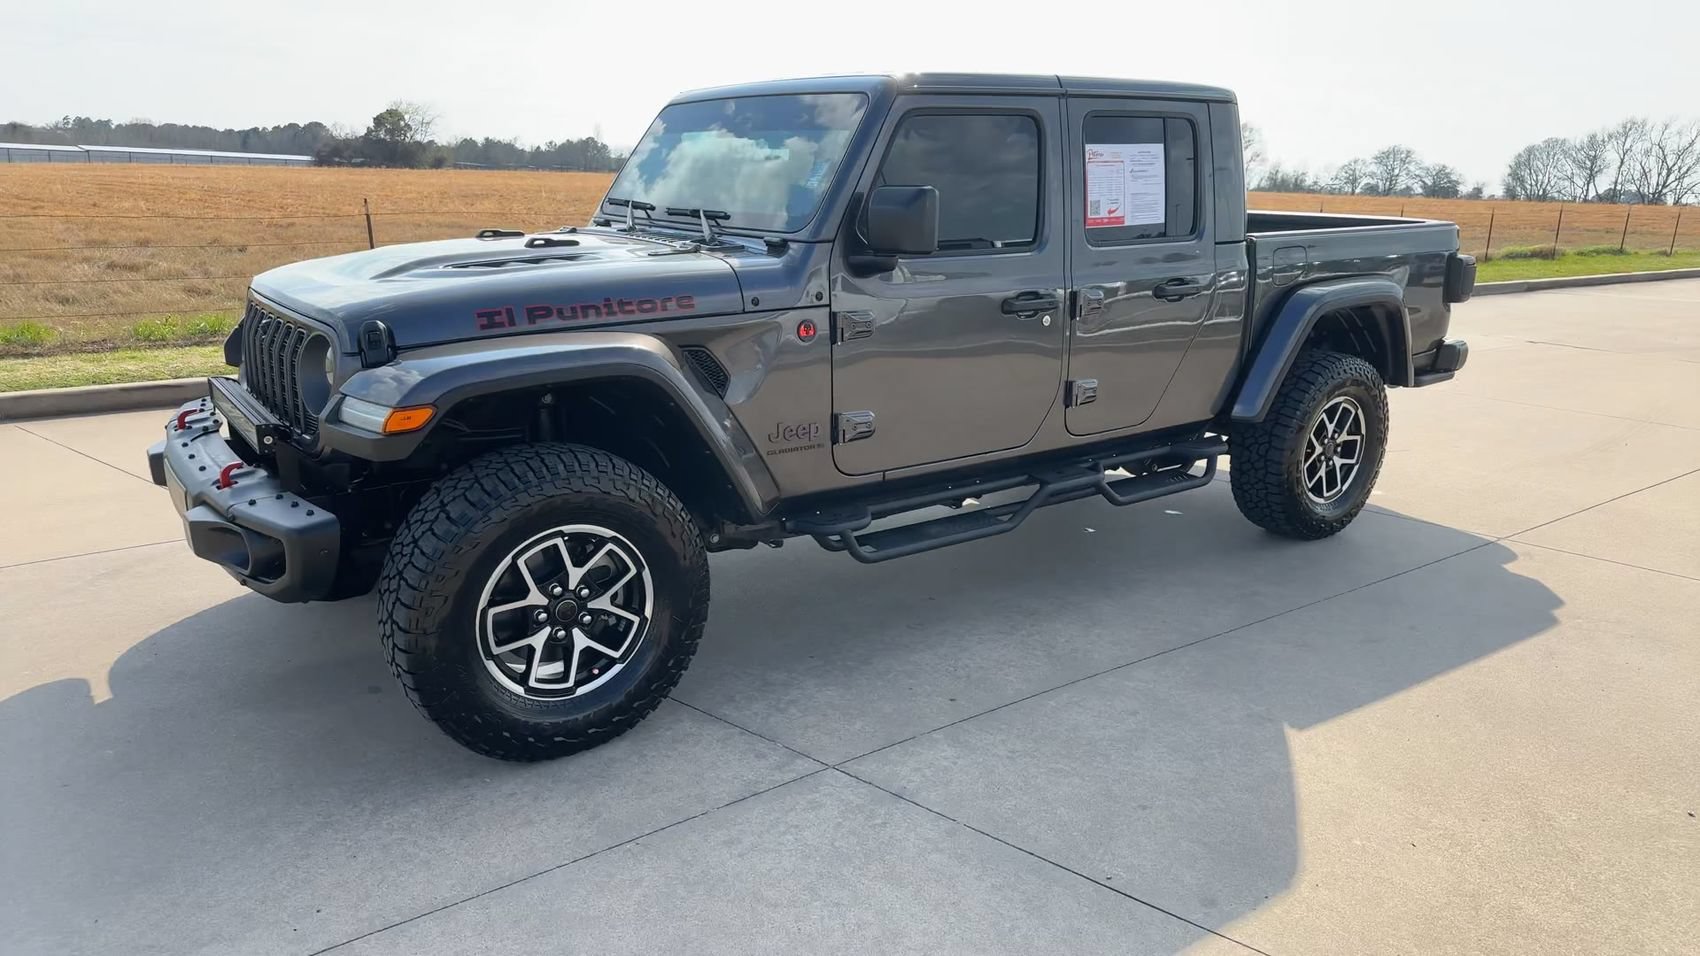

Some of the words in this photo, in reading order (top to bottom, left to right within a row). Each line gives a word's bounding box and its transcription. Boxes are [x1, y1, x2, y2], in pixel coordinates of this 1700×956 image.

[475, 305, 516, 330] Il
[525, 295, 695, 325] Punitore
[768, 422, 819, 443] Jeep
[767, 444, 816, 456] GLADIATOR
